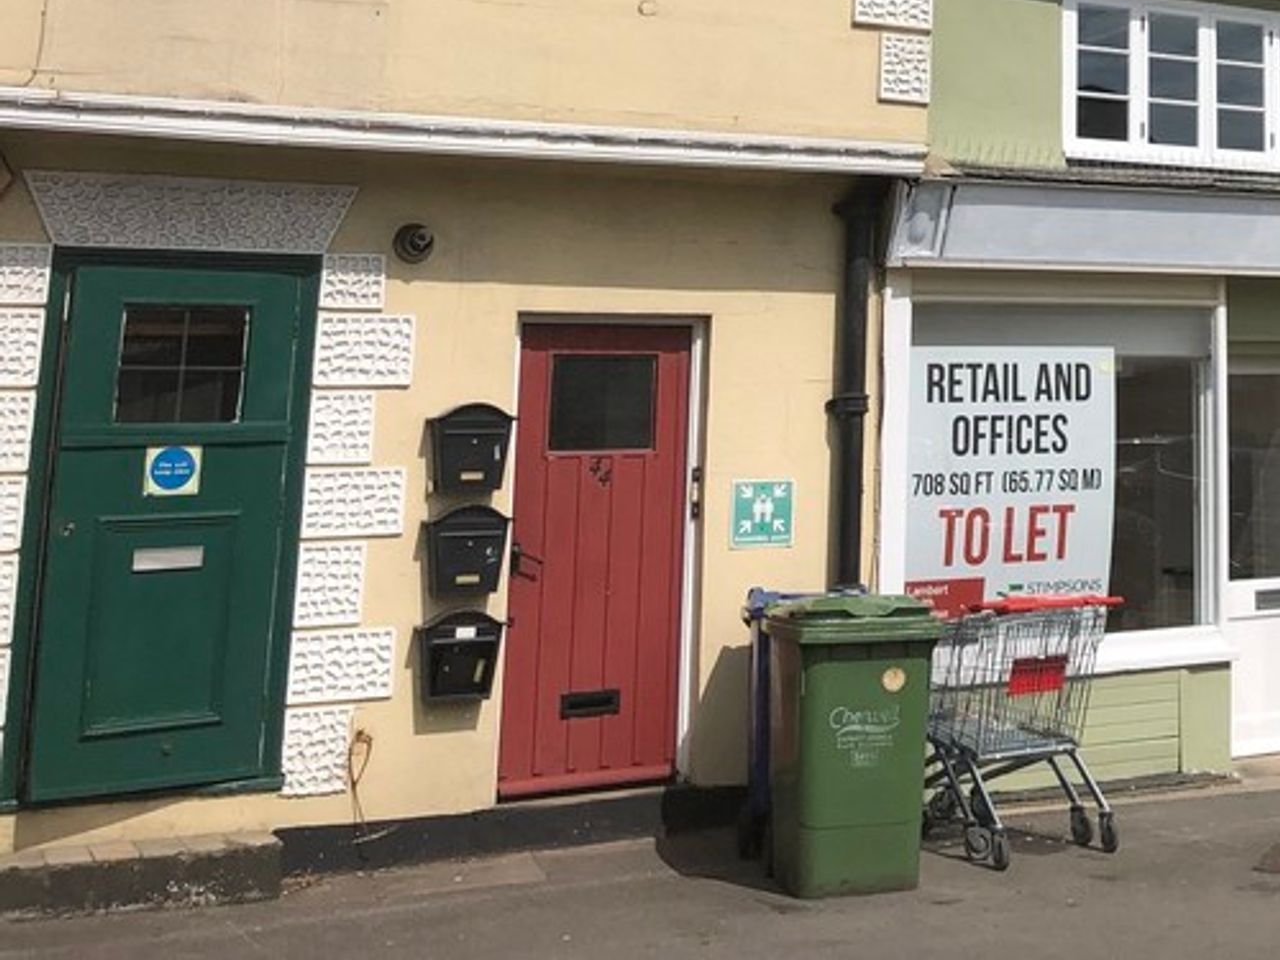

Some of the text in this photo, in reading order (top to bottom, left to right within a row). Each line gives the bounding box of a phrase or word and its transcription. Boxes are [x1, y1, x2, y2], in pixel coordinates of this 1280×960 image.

[926, 363, 1092, 404] RETAIL AND
[952, 414, 1068, 456] OFFICES
[912, 467, 1102, 497] 708 SQ FT (65.77 SQ M)
[939, 504, 1075, 567] TO LET
[1026, 578, 1103, 594] STIMPSONS
